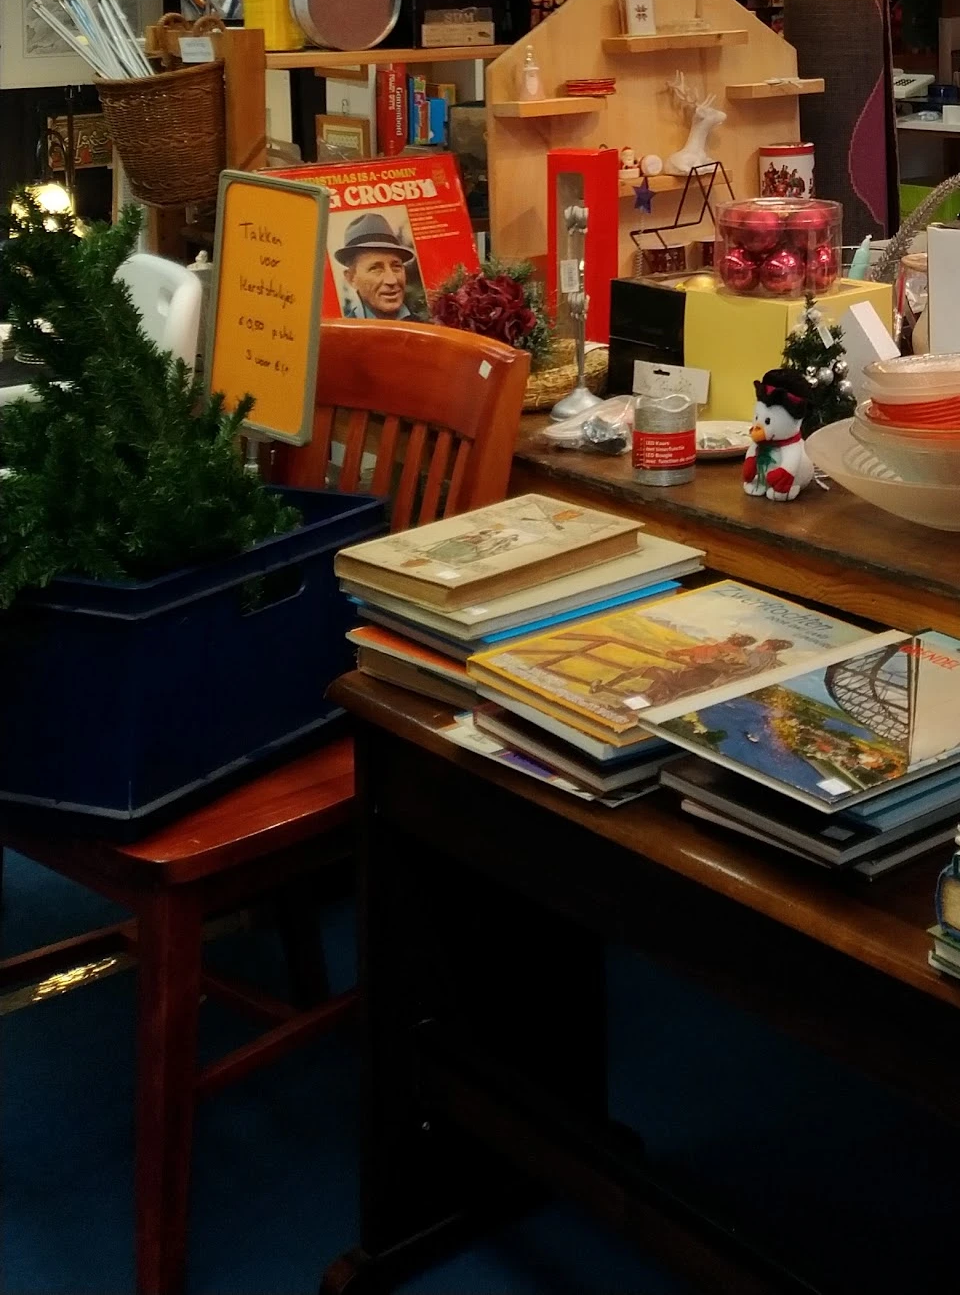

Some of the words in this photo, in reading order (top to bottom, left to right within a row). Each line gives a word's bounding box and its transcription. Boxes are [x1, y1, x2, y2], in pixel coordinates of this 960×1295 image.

[294, 171, 356, 186] HRISTMAS
[343, 179, 437, 206] CROSBY
[239, 221, 282, 246] Takken
[260, 255, 280, 267] voor
[712, 585, 833, 631] Zwerftochten
